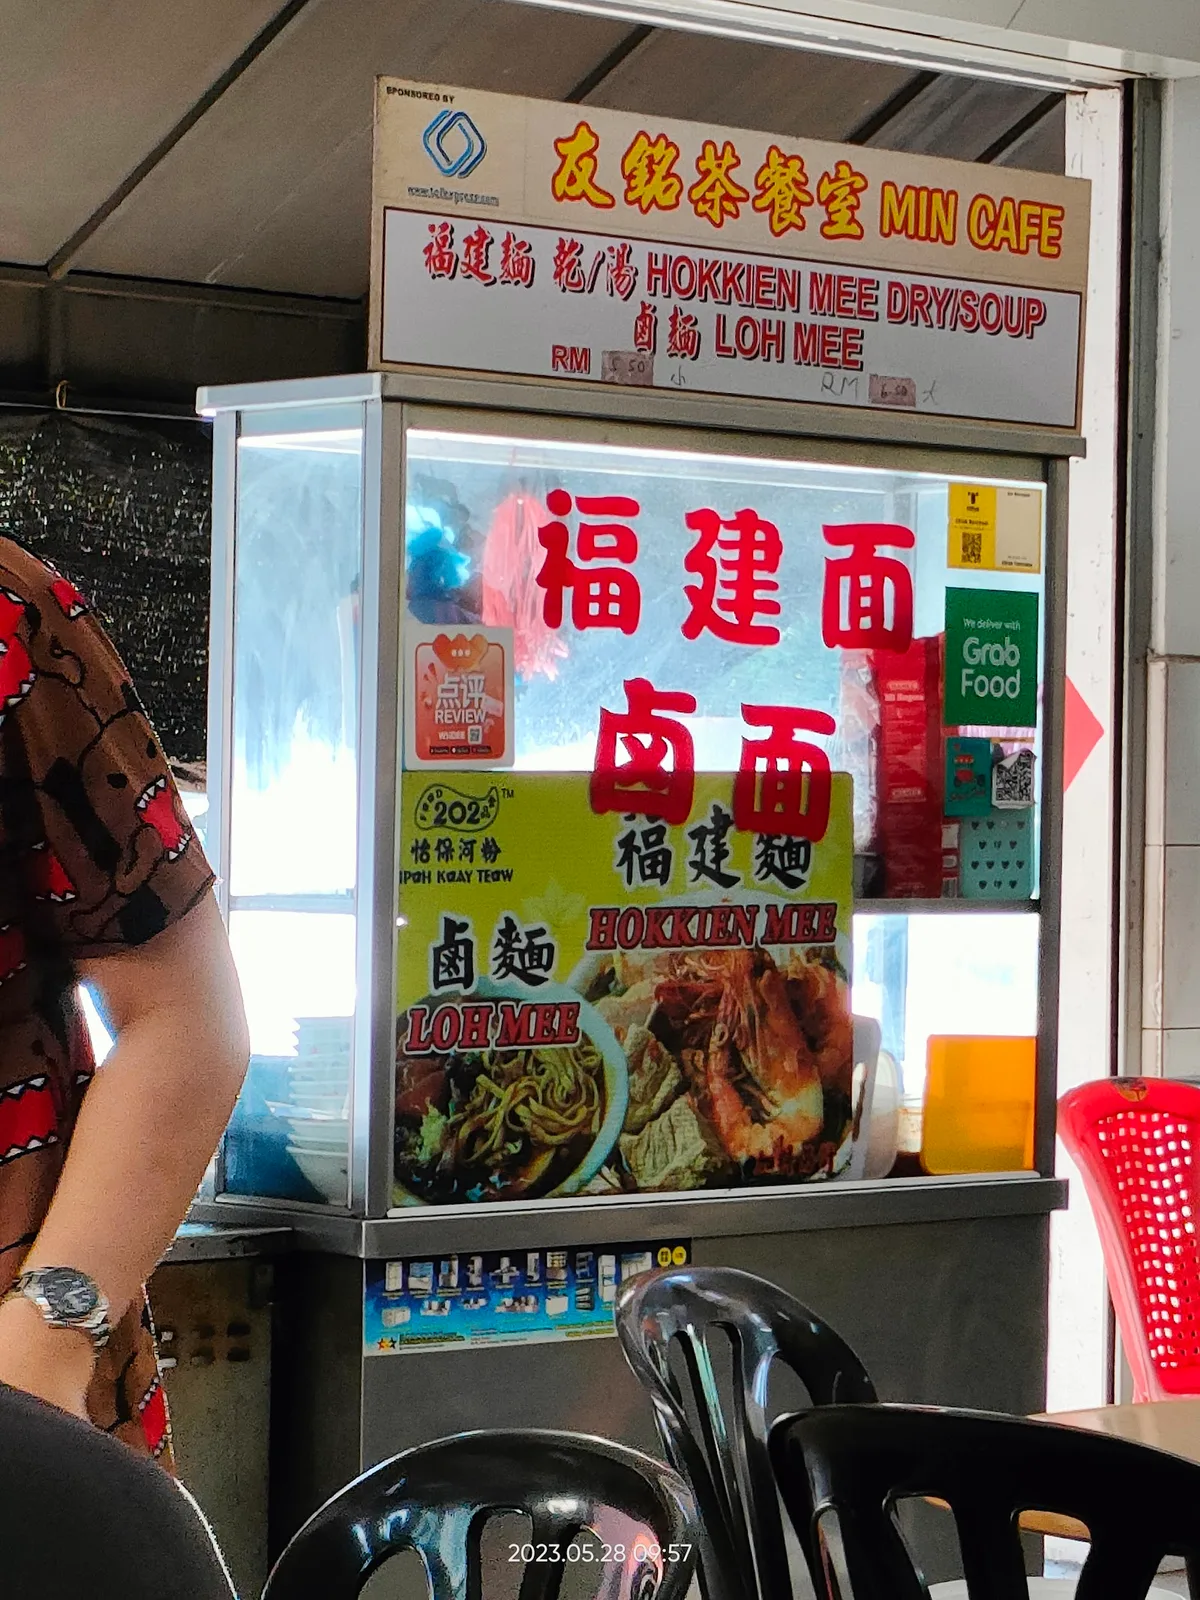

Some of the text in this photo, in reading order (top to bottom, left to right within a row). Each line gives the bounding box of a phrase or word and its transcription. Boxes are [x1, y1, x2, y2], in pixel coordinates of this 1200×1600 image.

[386, 86, 455, 104] SPONSORED BY
[551, 120, 869, 241] 友銘茶餐室
[879, 181, 1065, 259] MIN CAFE
[646, 252, 1047, 339] HOKKIEN MEE DRY/SOUP
[715, 313, 865, 371] LOH MEE
[551, 344, 591, 374] RM
[820, 371, 859, 399] RM
[536, 489, 915, 654] 福建面
[963, 618, 1020, 631] We deliver with
[962, 635, 1020, 667] Grab
[436, 672, 485, 709] 点评
[961, 668, 1021, 699] Food
[434, 708, 487, 725] REVIEW
[501, 788, 514, 798] TM
[411, 837, 501, 864] 怡保河粉
[477, 868, 513, 883] TEOW
[586, 902, 838, 951] HOKKIEN MEE
[404, 1001, 581, 1052] LOH MEE
